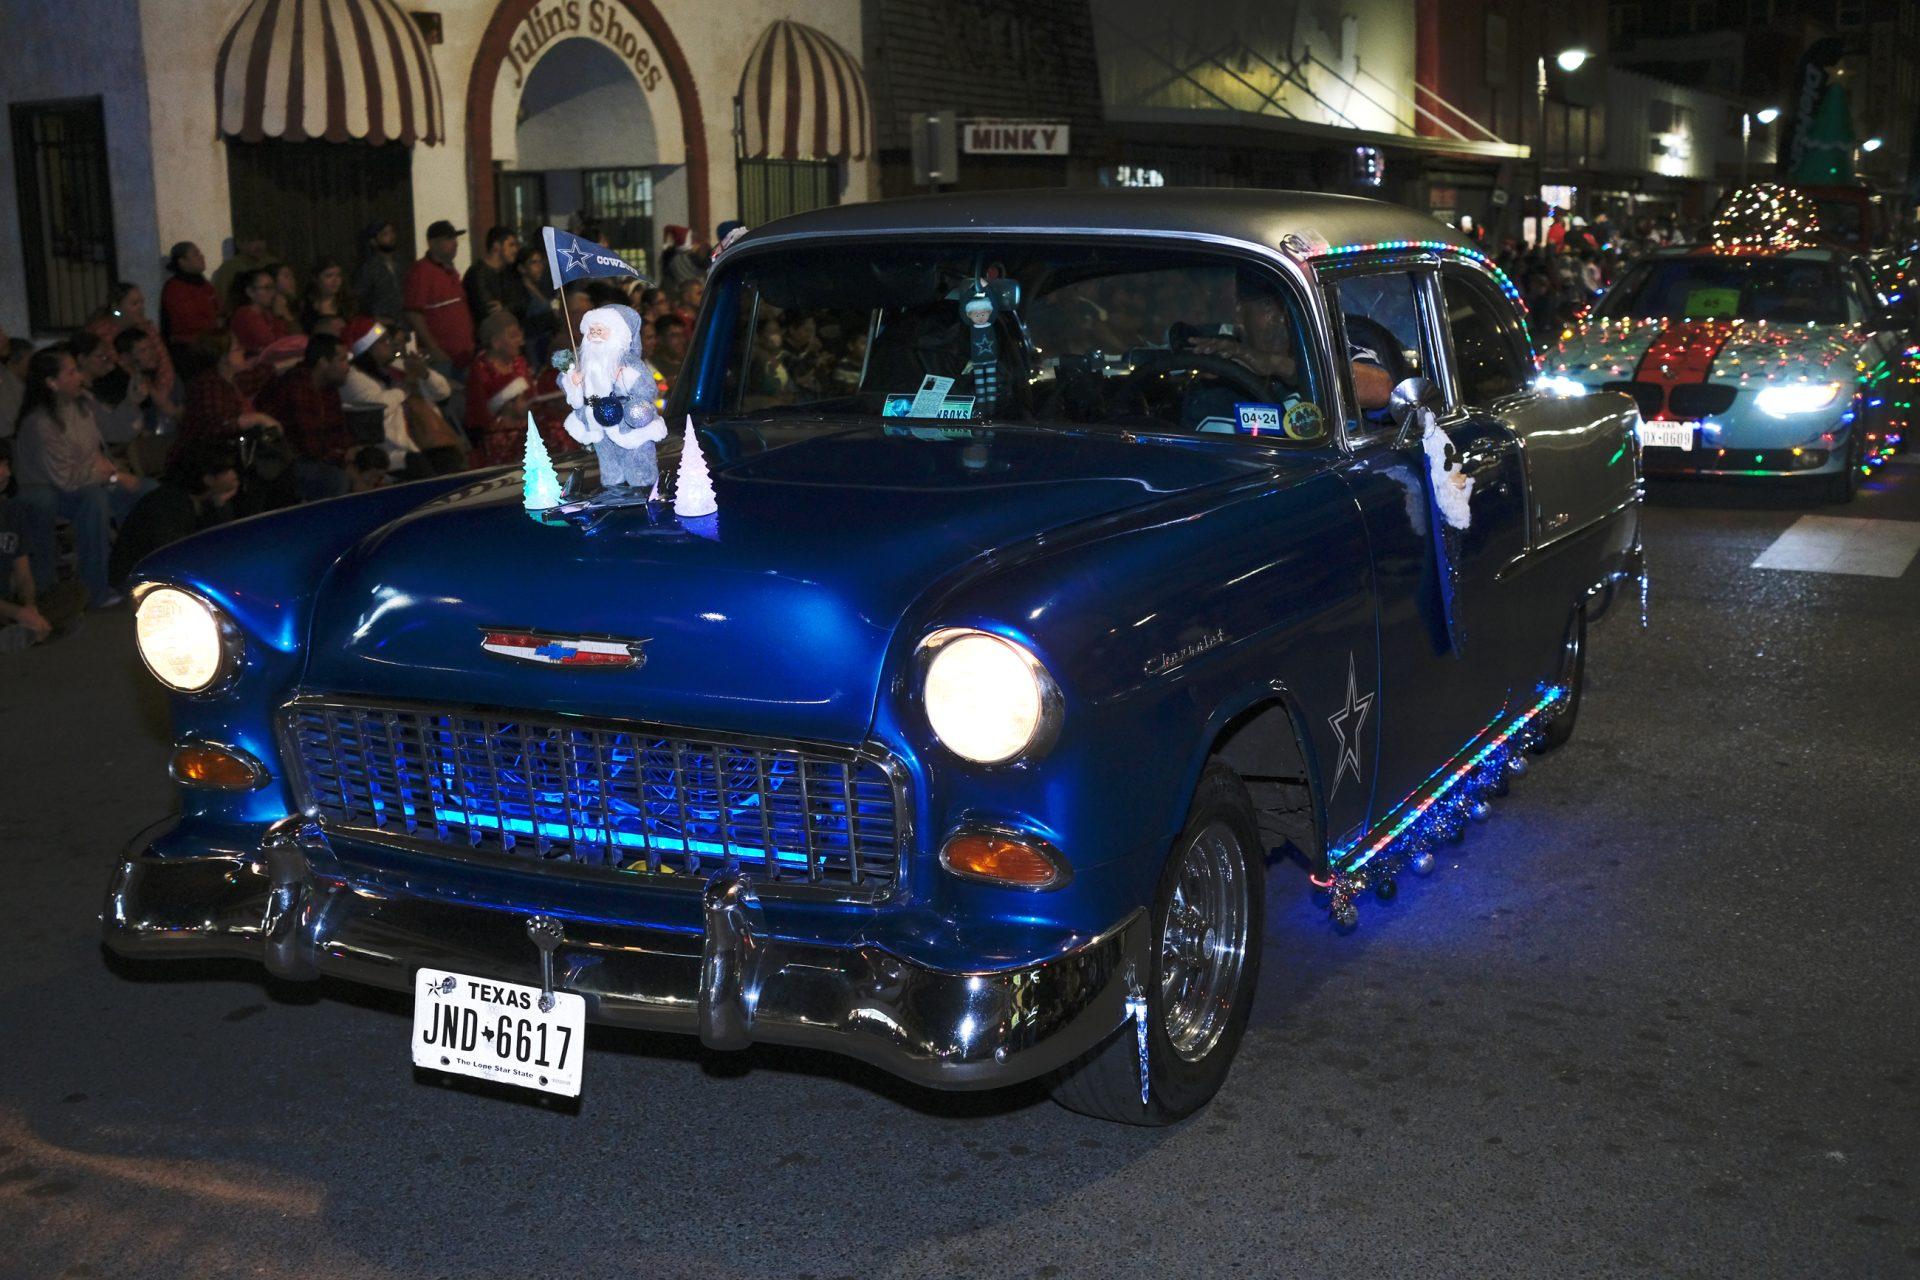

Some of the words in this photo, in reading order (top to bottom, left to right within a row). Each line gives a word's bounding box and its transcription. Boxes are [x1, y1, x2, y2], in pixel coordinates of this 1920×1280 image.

[507, 0, 580, 89] Julin's
[589, 0, 663, 92] Shoes
[971, 128, 1058, 150] MINKY
[468, 981, 531, 1010] TEXAS
[456, 1057, 471, 1067] The
[473, 1059, 492, 1071] Lone
[494, 1065, 511, 1075] Star
[512, 1069, 534, 1079] State
